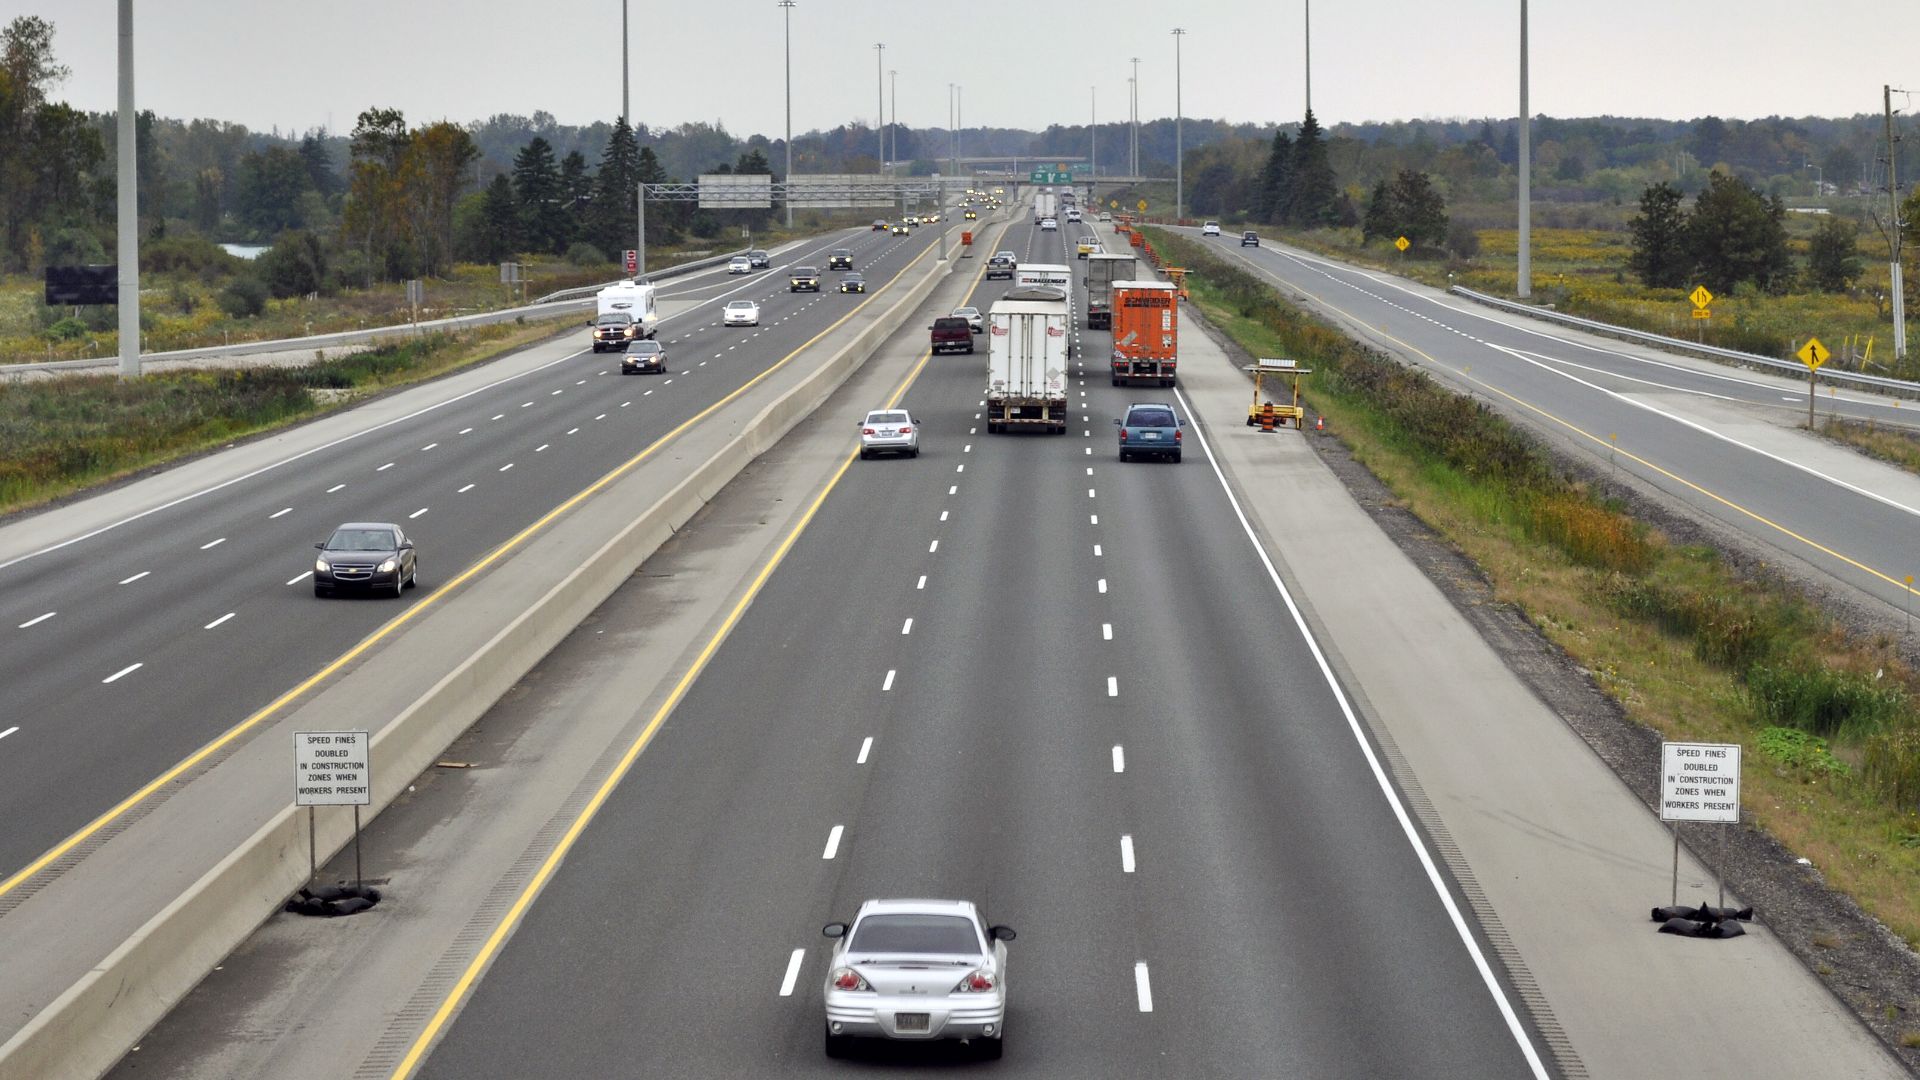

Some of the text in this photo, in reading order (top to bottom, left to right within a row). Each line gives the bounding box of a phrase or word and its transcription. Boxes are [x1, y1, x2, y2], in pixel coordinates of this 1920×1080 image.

[307, 736, 356, 744] SPEED FINES
[315, 750, 349, 758] DOUBLED
[1676, 749, 1727, 758] SPEED FINES
[311, 762, 364, 770] CONSTRUCTION
[1684, 763, 1718, 772] DOUBLED
[308, 773, 357, 782] ZONES WHEN
[1679, 776, 1734, 785] CONSTRUCTION
[298, 786, 367, 795] WORKERS PRESENT
[1675, 787, 1726, 796] ZONES WHEN
[1665, 801, 1735, 811] WORKERS PRESENT
